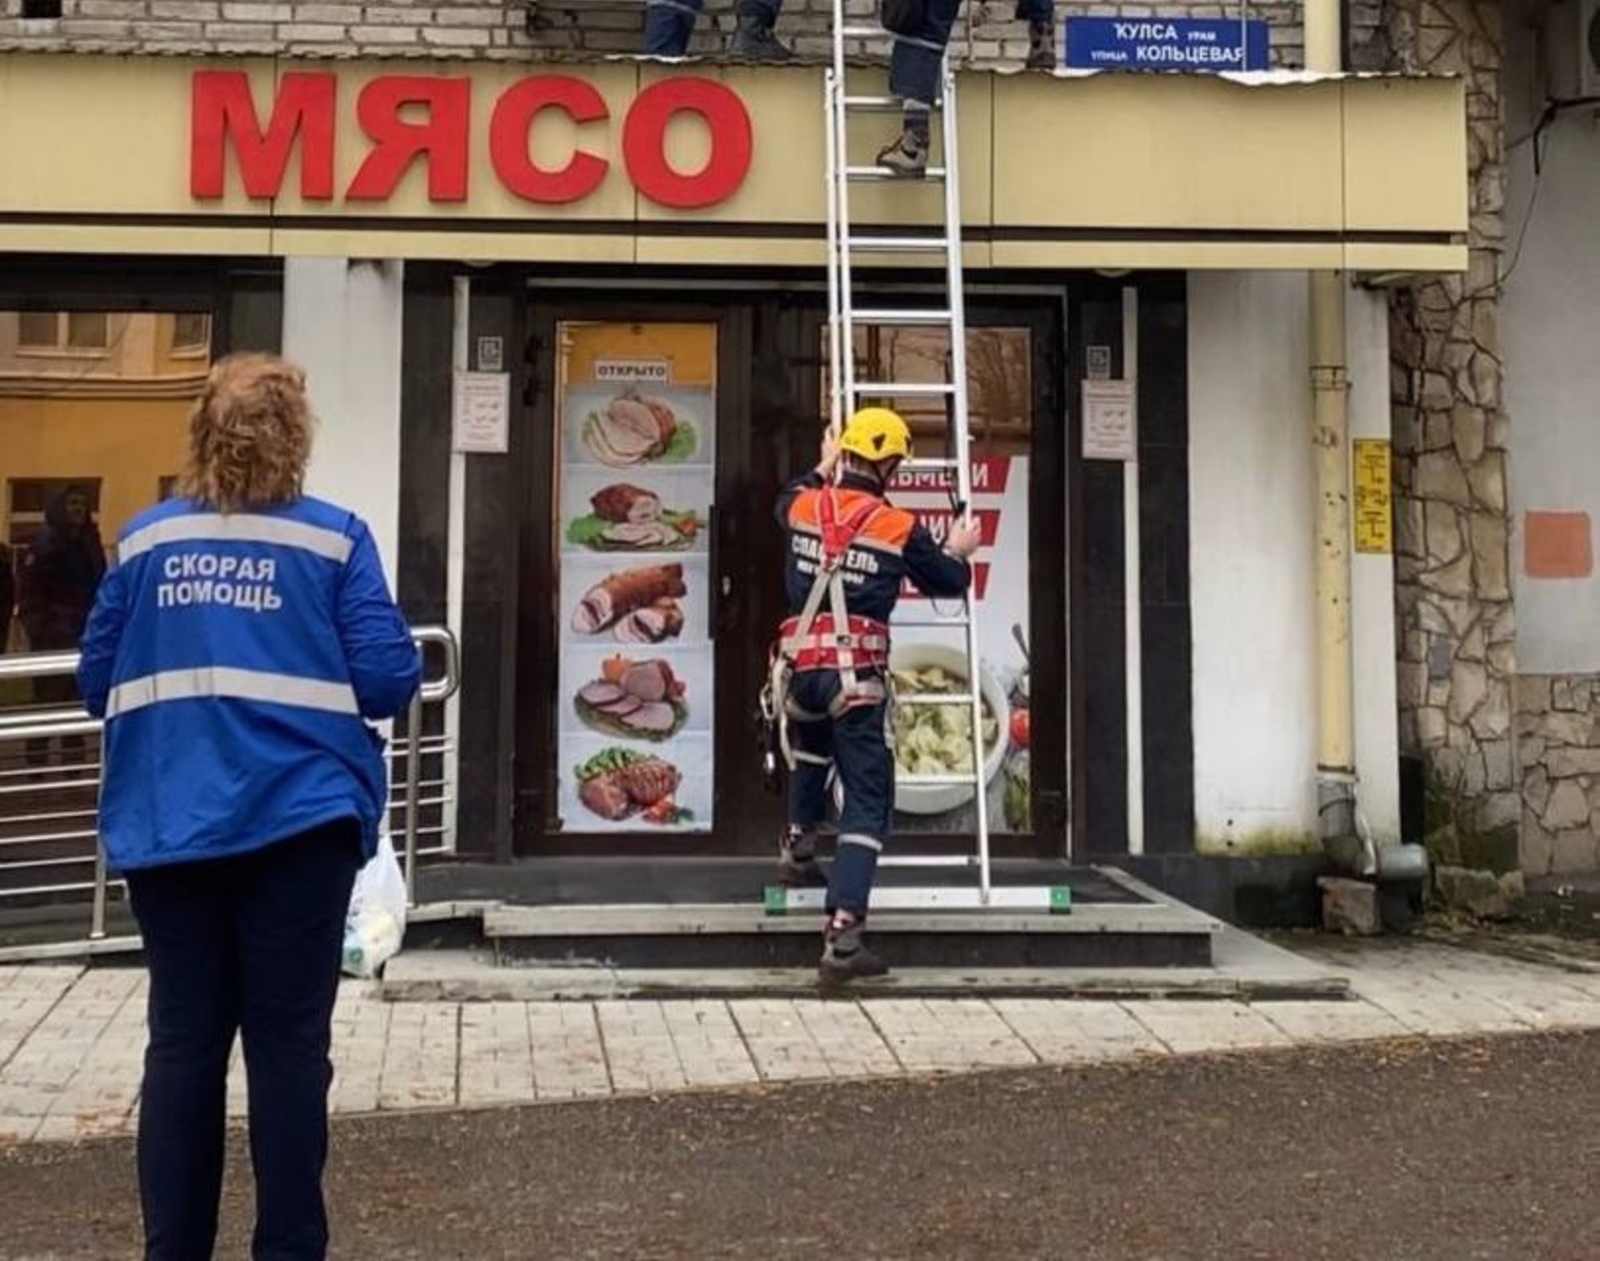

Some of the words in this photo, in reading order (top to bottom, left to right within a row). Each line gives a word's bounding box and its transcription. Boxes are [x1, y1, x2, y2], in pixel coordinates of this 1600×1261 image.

[1136, 45, 1243, 63] КОЛЬЦЕВАЯ
[190, 70, 753, 209] МЯСО
[598, 365, 665, 377] ОТКРЫТО
[164, 553, 276, 582] СКОРАЯ
[792, 534, 879, 574] СПАЕЛЬ
[157, 580, 283, 613] ПОМОЩЬ
